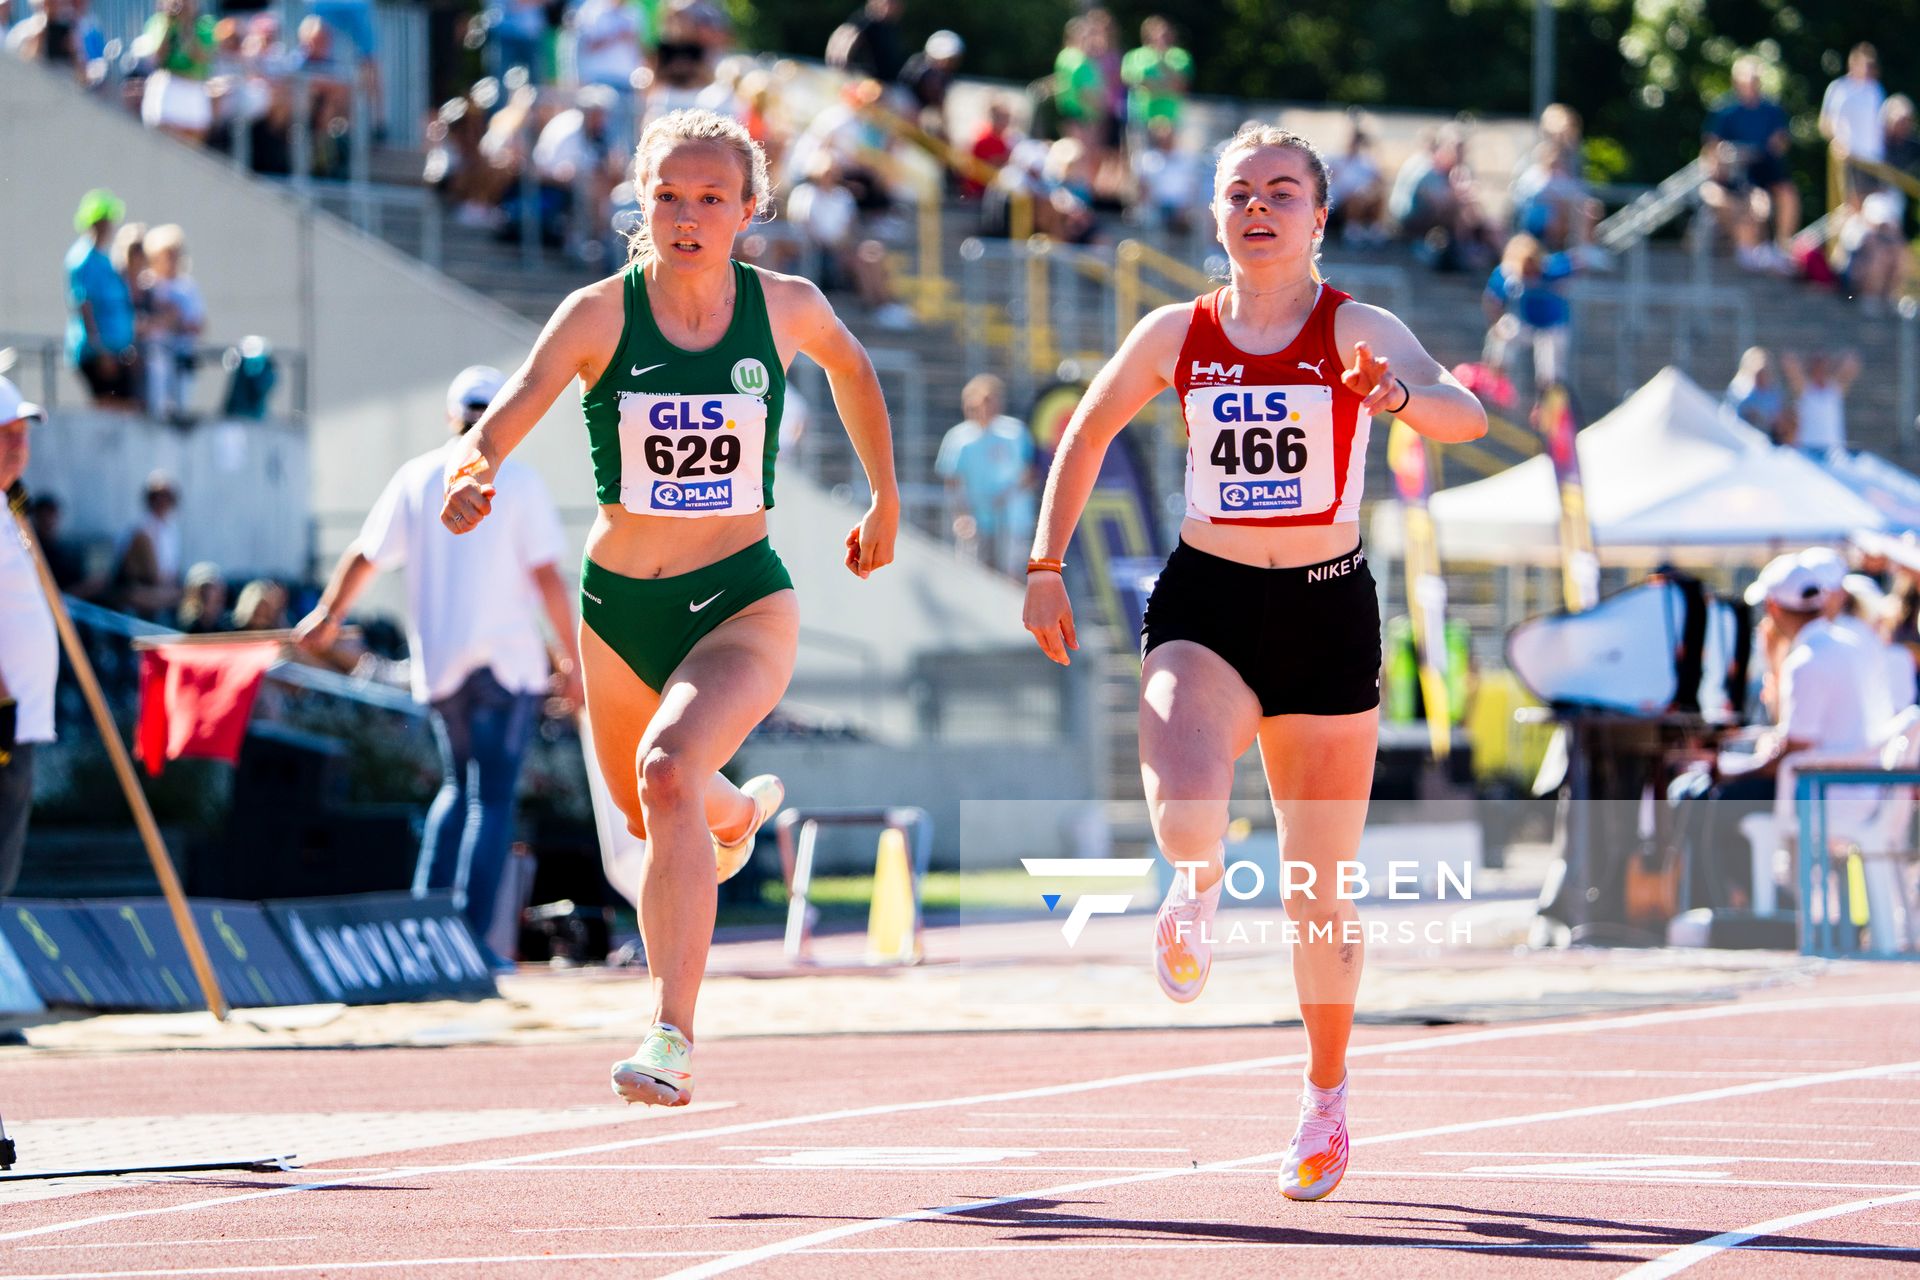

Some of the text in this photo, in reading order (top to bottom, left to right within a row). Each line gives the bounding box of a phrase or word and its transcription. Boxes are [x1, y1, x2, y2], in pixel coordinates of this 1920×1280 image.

[739, 365, 763, 389] W
[643, 434, 741, 478] 629
[1210, 426, 1308, 475] 466
[684, 485, 729, 501] PLAN
[1251, 484, 1299, 500] PLAN
[1308, 558, 1351, 583] NIKE
